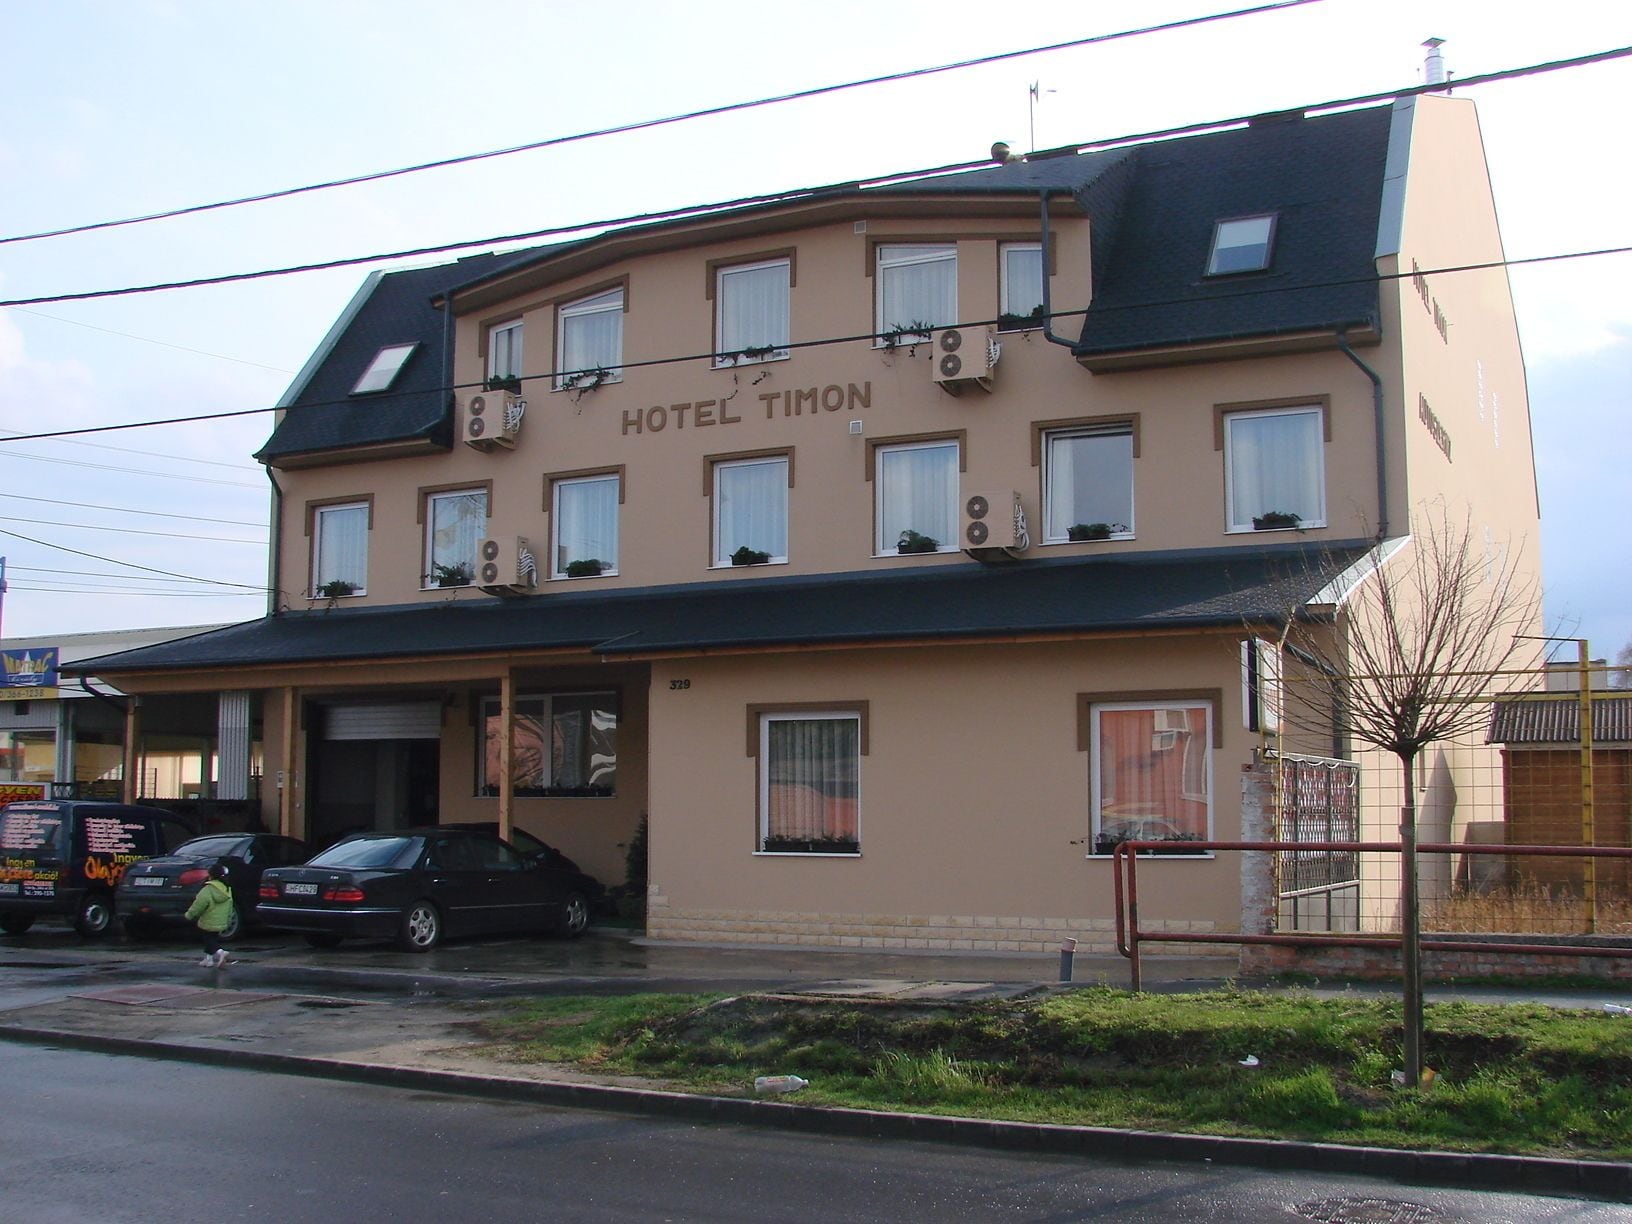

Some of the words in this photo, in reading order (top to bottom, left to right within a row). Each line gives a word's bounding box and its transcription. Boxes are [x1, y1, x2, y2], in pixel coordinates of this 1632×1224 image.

[622, 399, 741, 435] HOTEL
[758, 381, 872, 419] TIMON
[669, 679, 691, 690] 329
